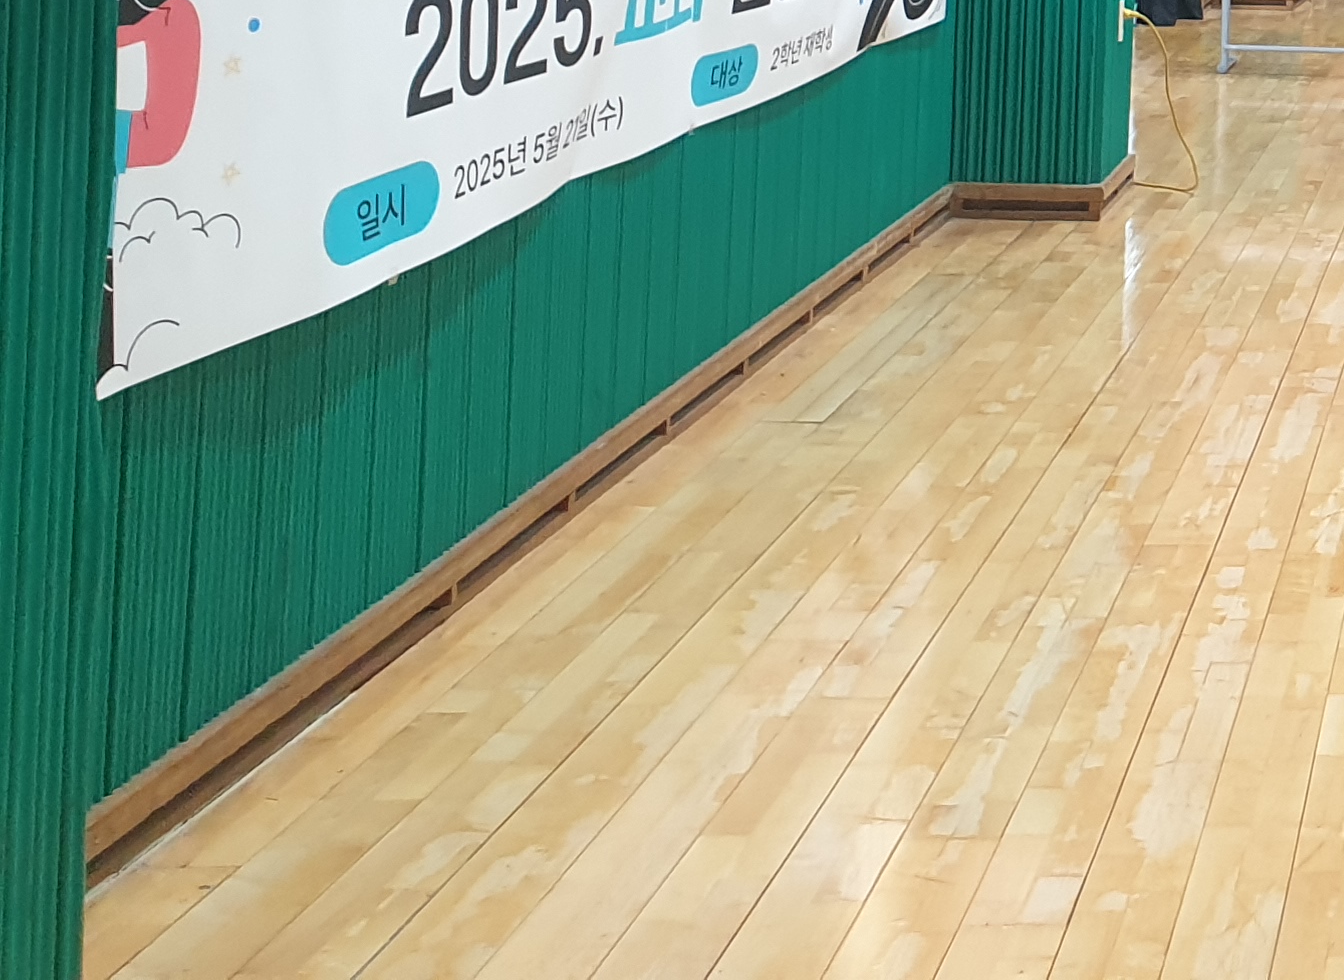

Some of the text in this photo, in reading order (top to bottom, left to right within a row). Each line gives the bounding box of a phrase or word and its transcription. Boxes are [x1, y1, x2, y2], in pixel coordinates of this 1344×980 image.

[710, 55, 743, 89] 대상
[770, 36, 803, 71] 2학년
[356, 95, 624, 242] 일시 2025년 5월 21일(수)
